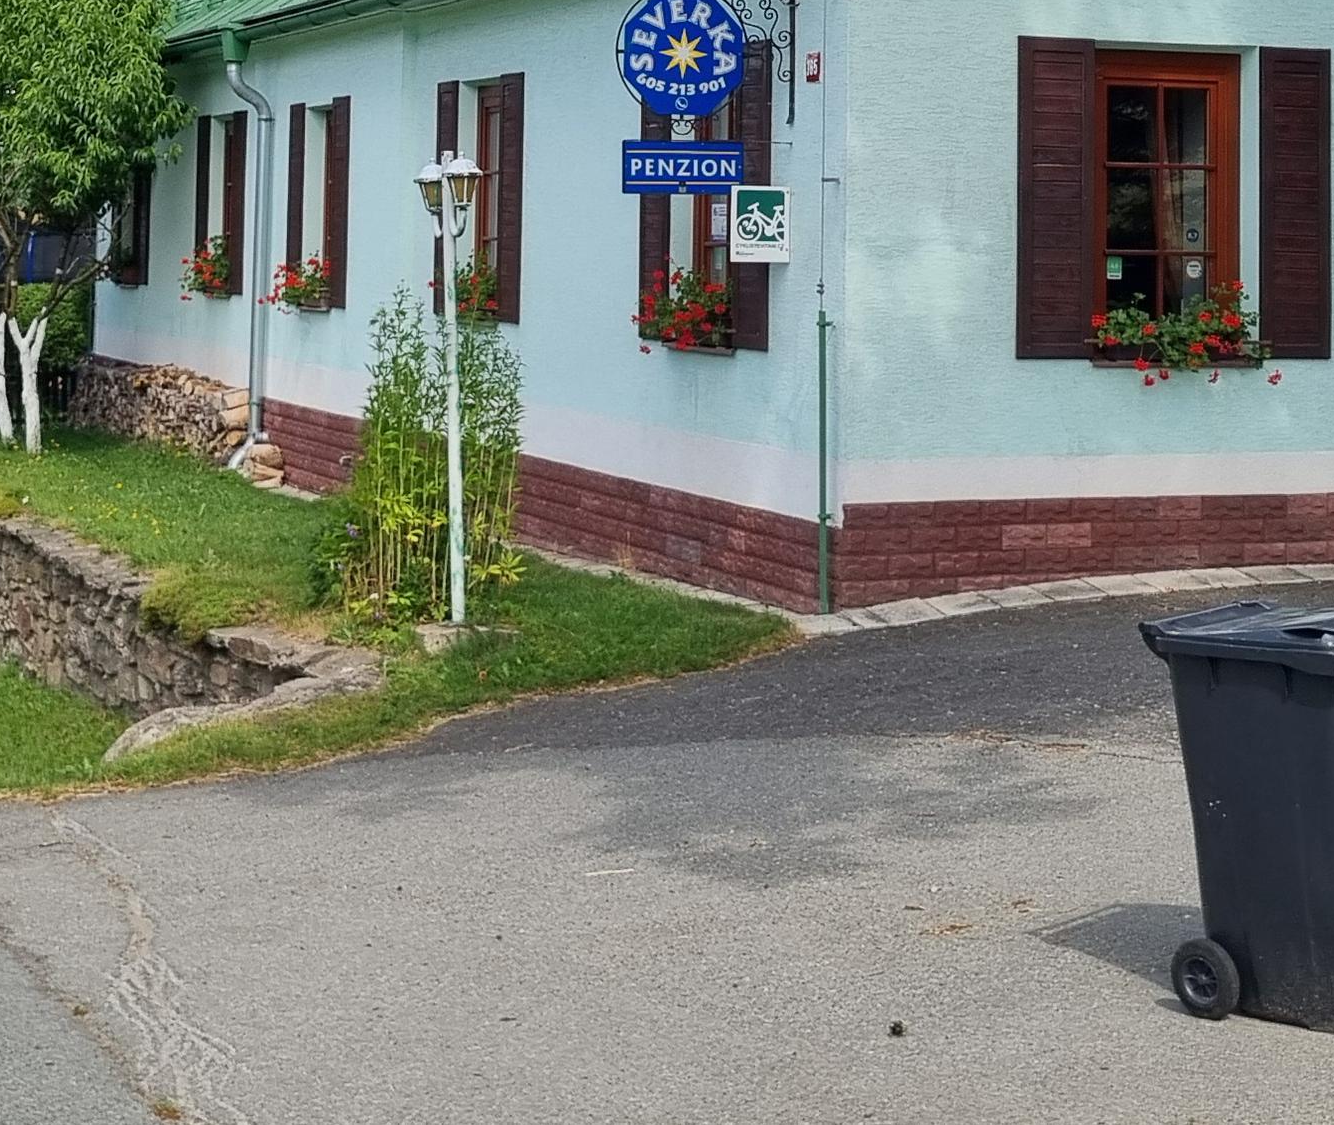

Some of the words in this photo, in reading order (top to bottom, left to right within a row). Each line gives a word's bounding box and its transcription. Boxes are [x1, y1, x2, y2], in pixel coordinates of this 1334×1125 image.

[636, 73, 666, 92] 605
[668, 82, 696, 95] 213
[699, 76, 726, 94] 901
[630, 158, 736, 177] PENZION
